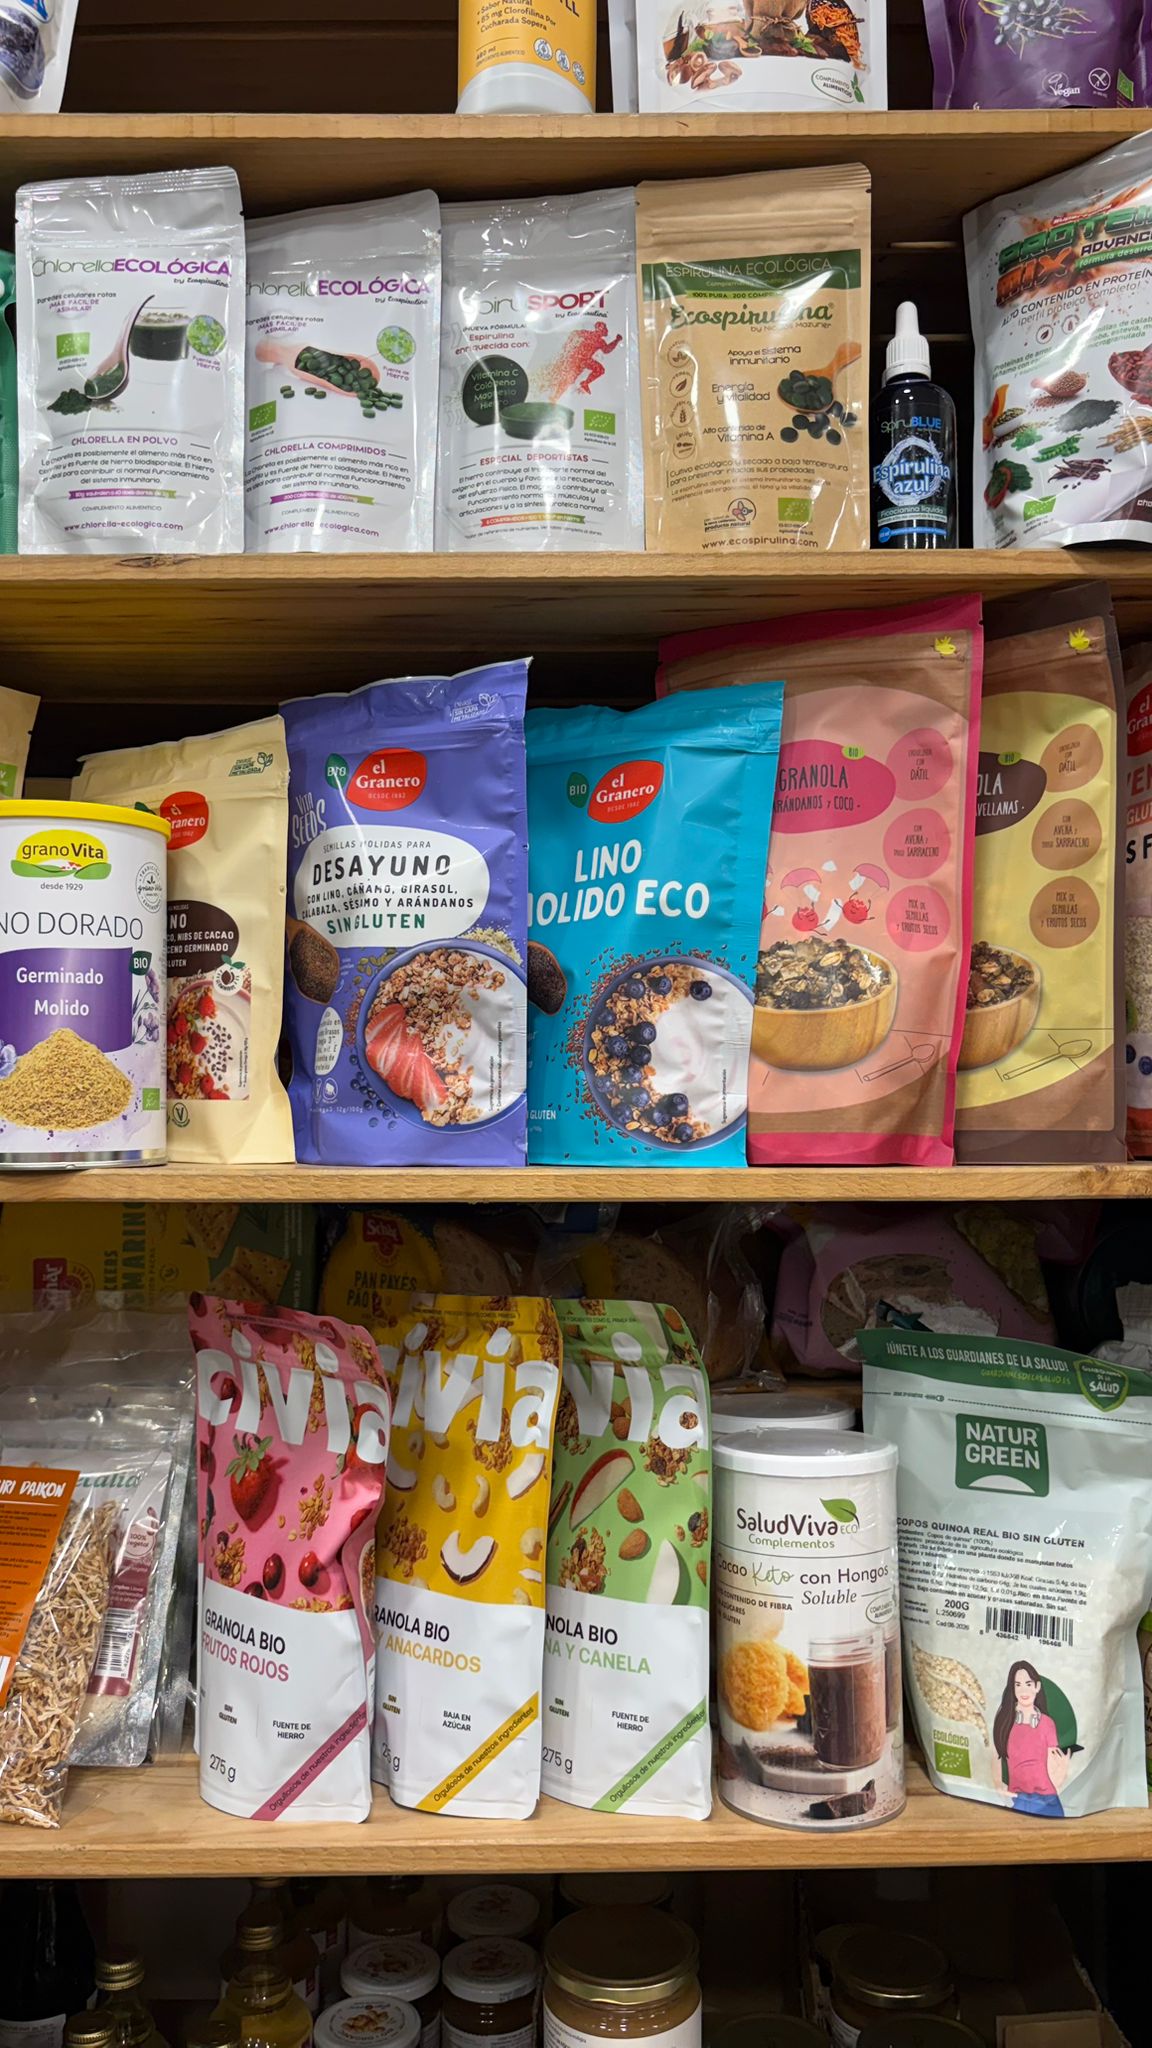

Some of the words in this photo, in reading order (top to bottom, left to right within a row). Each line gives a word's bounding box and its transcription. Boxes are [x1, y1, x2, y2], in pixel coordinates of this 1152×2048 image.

[504, 7, 545, 20] Clorofilina
[481, 17, 520, 33] Cucharada
[521, 17, 548, 31] Sopera
[665, 264, 743, 279] ESPIRULINA
[745, 254, 832, 276] ECOLÓGICA
[1080, 253, 1116, 269] fórmula
[997, 246, 1076, 308] MIX
[1001, 309, 1020, 328] ALTO
[1019, 285, 1084, 315] CONTENIDO
[1085, 279, 1102, 292] EN
[1046, 295, 1088, 319] proteico
[1087, 281, 1141, 303] completo!
[469, 332, 516, 342] Espirulina
[711, 381, 755, 394] Energía
[726, 390, 772, 403] vitalidad
[71, 436, 126, 447] CHLORELLA
[127, 436, 142, 444] EN
[143, 437, 179, 446] POLVO
[717, 432, 765, 444] Vitamina
[767, 432, 776, 442] A
[264, 442, 315, 458] CHLORELLA
[317, 442, 388, 458] COMPRIMIDOS
[480, 454, 523, 467] ESPECIAL
[526, 453, 591, 463] DEPORTISTAS
[873, 456, 950, 483] Espirulina
[893, 475, 930, 494] azul
[64, 519, 185, 533] www.chlorella-ecologica.com
[701, 534, 820, 550] www.ecospirulina.com
[372, 759, 386, 775] el
[911, 765, 929, 782] DÁTIL
[1058, 757, 1077, 774] DÁTIL
[355, 773, 422, 790] Granero
[611, 772, 625, 789] el
[780, 763, 849, 792] GRANOLA
[568, 783, 588, 797] BIO
[595, 783, 656, 805] Granero
[833, 795, 855, 812] COCO
[977, 800, 1019, 816] VELLANAS
[293, 798, 328, 850] SEEDS
[1053, 825, 1073, 836] AVENA
[322, 839, 357, 855] SEMILLAS
[406, 840, 433, 849] PARA
[905, 834, 924, 846] AVENA
[1055, 836, 1090, 849] SARRACENO
[574, 838, 643, 883] LINO
[907, 846, 940, 858] SARRACENO
[312, 853, 452, 887] DESAYUNO
[40, 882, 64, 891] desde
[64, 883, 84, 891] 1929
[306, 891, 322, 905] CON
[322, 888, 345, 901] LINO,
[400, 883, 460, 896] GIRASOL,
[634, 879, 711, 920] ECO
[908, 898, 919, 910] MIX
[1056, 891, 1068, 902] MIX
[301, 901, 342, 921] CALABAZA,
[396, 895, 475, 909] ARÁNDANOS
[905, 910, 930, 922] SEMILLAS
[1051, 903, 1079, 915] SEMILLAS
[37, 912, 143, 940] DORADO
[326, 917, 352, 935] SIN
[353, 912, 426, 931] GLUTEN
[923, 923, 939, 936] SECOS
[1070, 917, 1088, 929] SECOS
[177, 932, 193, 942] NIBS
[203, 930, 235, 940] CACAO
[184, 942, 230, 953] GERMINADO
[132, 956, 149, 970] BIO
[16, 966, 105, 985] Germinado
[34, 999, 90, 1017] Molido
[530, 1109, 557, 1121] GLUTEN
[354, 1270, 378, 1290] PAN
[380, 1271, 418, 1292] PAYÉS
[885, 1338, 919, 1359] ¡ÚNETE
[919, 1345, 927, 1358] A
[927, 1345, 945, 1361] LOS
[945, 1347, 1005, 1368] GUARDIANES
[1006, 1351, 1020, 1367] DE
[1020, 1354, 1034, 1369] LA
[1033, 1354, 1070, 1377] SALUD!
[1089, 1379, 1120, 1395] SALUD
[195, 1328, 391, 1465] civia
[965, 1421, 1040, 1450] NATUR
[964, 1442, 1041, 1471] GREEN
[19, 1482, 67, 1504] DAIKON
[736, 1506, 840, 1538] SaludViva
[839, 1522, 859, 1535] ECO
[748, 1532, 836, 1551] Complementos
[897, 1516, 929, 1530] COPOS
[930, 1520, 972, 1537] QUINOA
[972, 1525, 1001, 1537] REAL
[1001, 1530, 1021, 1542] BIO
[1021, 1533, 1041, 1545] SIN
[1041, 1534, 1086, 1550] GLUTEN
[752, 1561, 794, 1588] Keto
[799, 1573, 832, 1585] con
[837, 1564, 890, 1584] Hongos
[801, 1587, 858, 1606] Soluble
[943, 1598, 971, 1612] 200G
[769, 1601, 794, 1612] FIBRA
[204, 1607, 257, 1648] GRANOLA
[259, 1630, 287, 1656] BIO
[423, 1618, 451, 1643] BIO
[545, 1613, 585, 1642] NOLA
[587, 1624, 619, 1647] BIO
[201, 1632, 238, 1666] FRUTOS
[240, 1650, 291, 1683] ROJOS
[385, 1637, 483, 1674] ANACARDOS
[563, 1644, 576, 1661] Y
[578, 1646, 652, 1676] CANELA
[381, 1702, 401, 1716] GLUTEN
[442, 1709, 460, 1722] BAJA
[460, 1712, 473, 1723] EN
[548, 1705, 571, 1719] GLUTEN
[611, 1710, 638, 1723] FUENTE
[638, 1714, 651, 1724] DE
[218, 1711, 239, 1726] GLUTEN
[272, 1719, 300, 1732] FUENTE
[300, 1722, 312, 1732] DE
[441, 1720, 473, 1733] AZÚCAR
[276, 1730, 306, 1741] HIERRO
[616, 1721, 644, 1734] HIERRO
[932, 1728, 969, 1748] ECOLÓGICO
[432, 1772, 466, 1804] Orgullosos
[463, 1761, 475, 1777] de
[471, 1737, 501, 1764] nuestros
[495, 1705, 536, 1744] ingredientes
[541, 1745, 563, 1769] 275
[563, 1758, 574, 1775] g
[209, 1752, 227, 1776] 275
[226, 1765, 238, 1784] g
[268, 1777, 302, 1812] Orgullosos
[300, 1768, 311, 1783] de
[308, 1741, 336, 1773] nuestros
[609, 1772, 641, 1804] Orgullosos
[638, 1760, 651, 1777] de
[647, 1736, 674, 1765] nuestros
